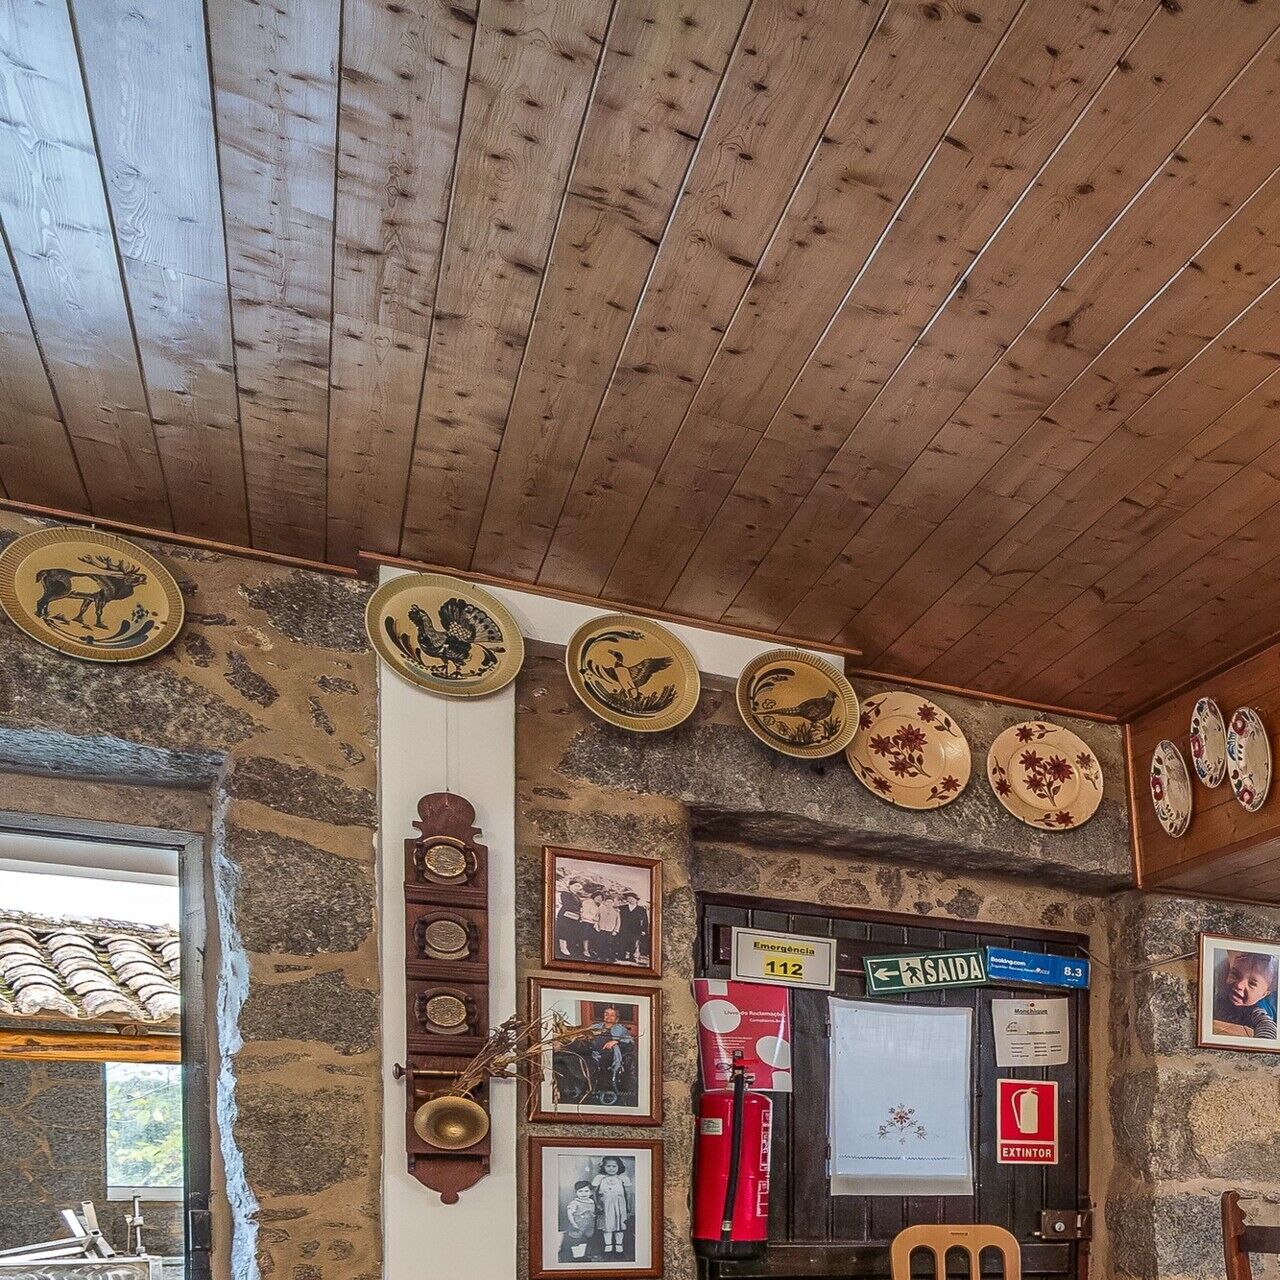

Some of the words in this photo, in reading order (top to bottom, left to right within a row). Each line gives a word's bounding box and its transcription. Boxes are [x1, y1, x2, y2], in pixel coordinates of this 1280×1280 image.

[753, 941, 815, 955] Emergência
[990, 956, 1026, 966] Booking.com
[765, 960, 803, 977] 112
[924, 956, 982, 983] SAIDA
[1063, 966, 1082, 977] 8.3
[1014, 1008, 1048, 1016] Monchique
[1002, 1147, 1051, 1158] EXTINTOR
